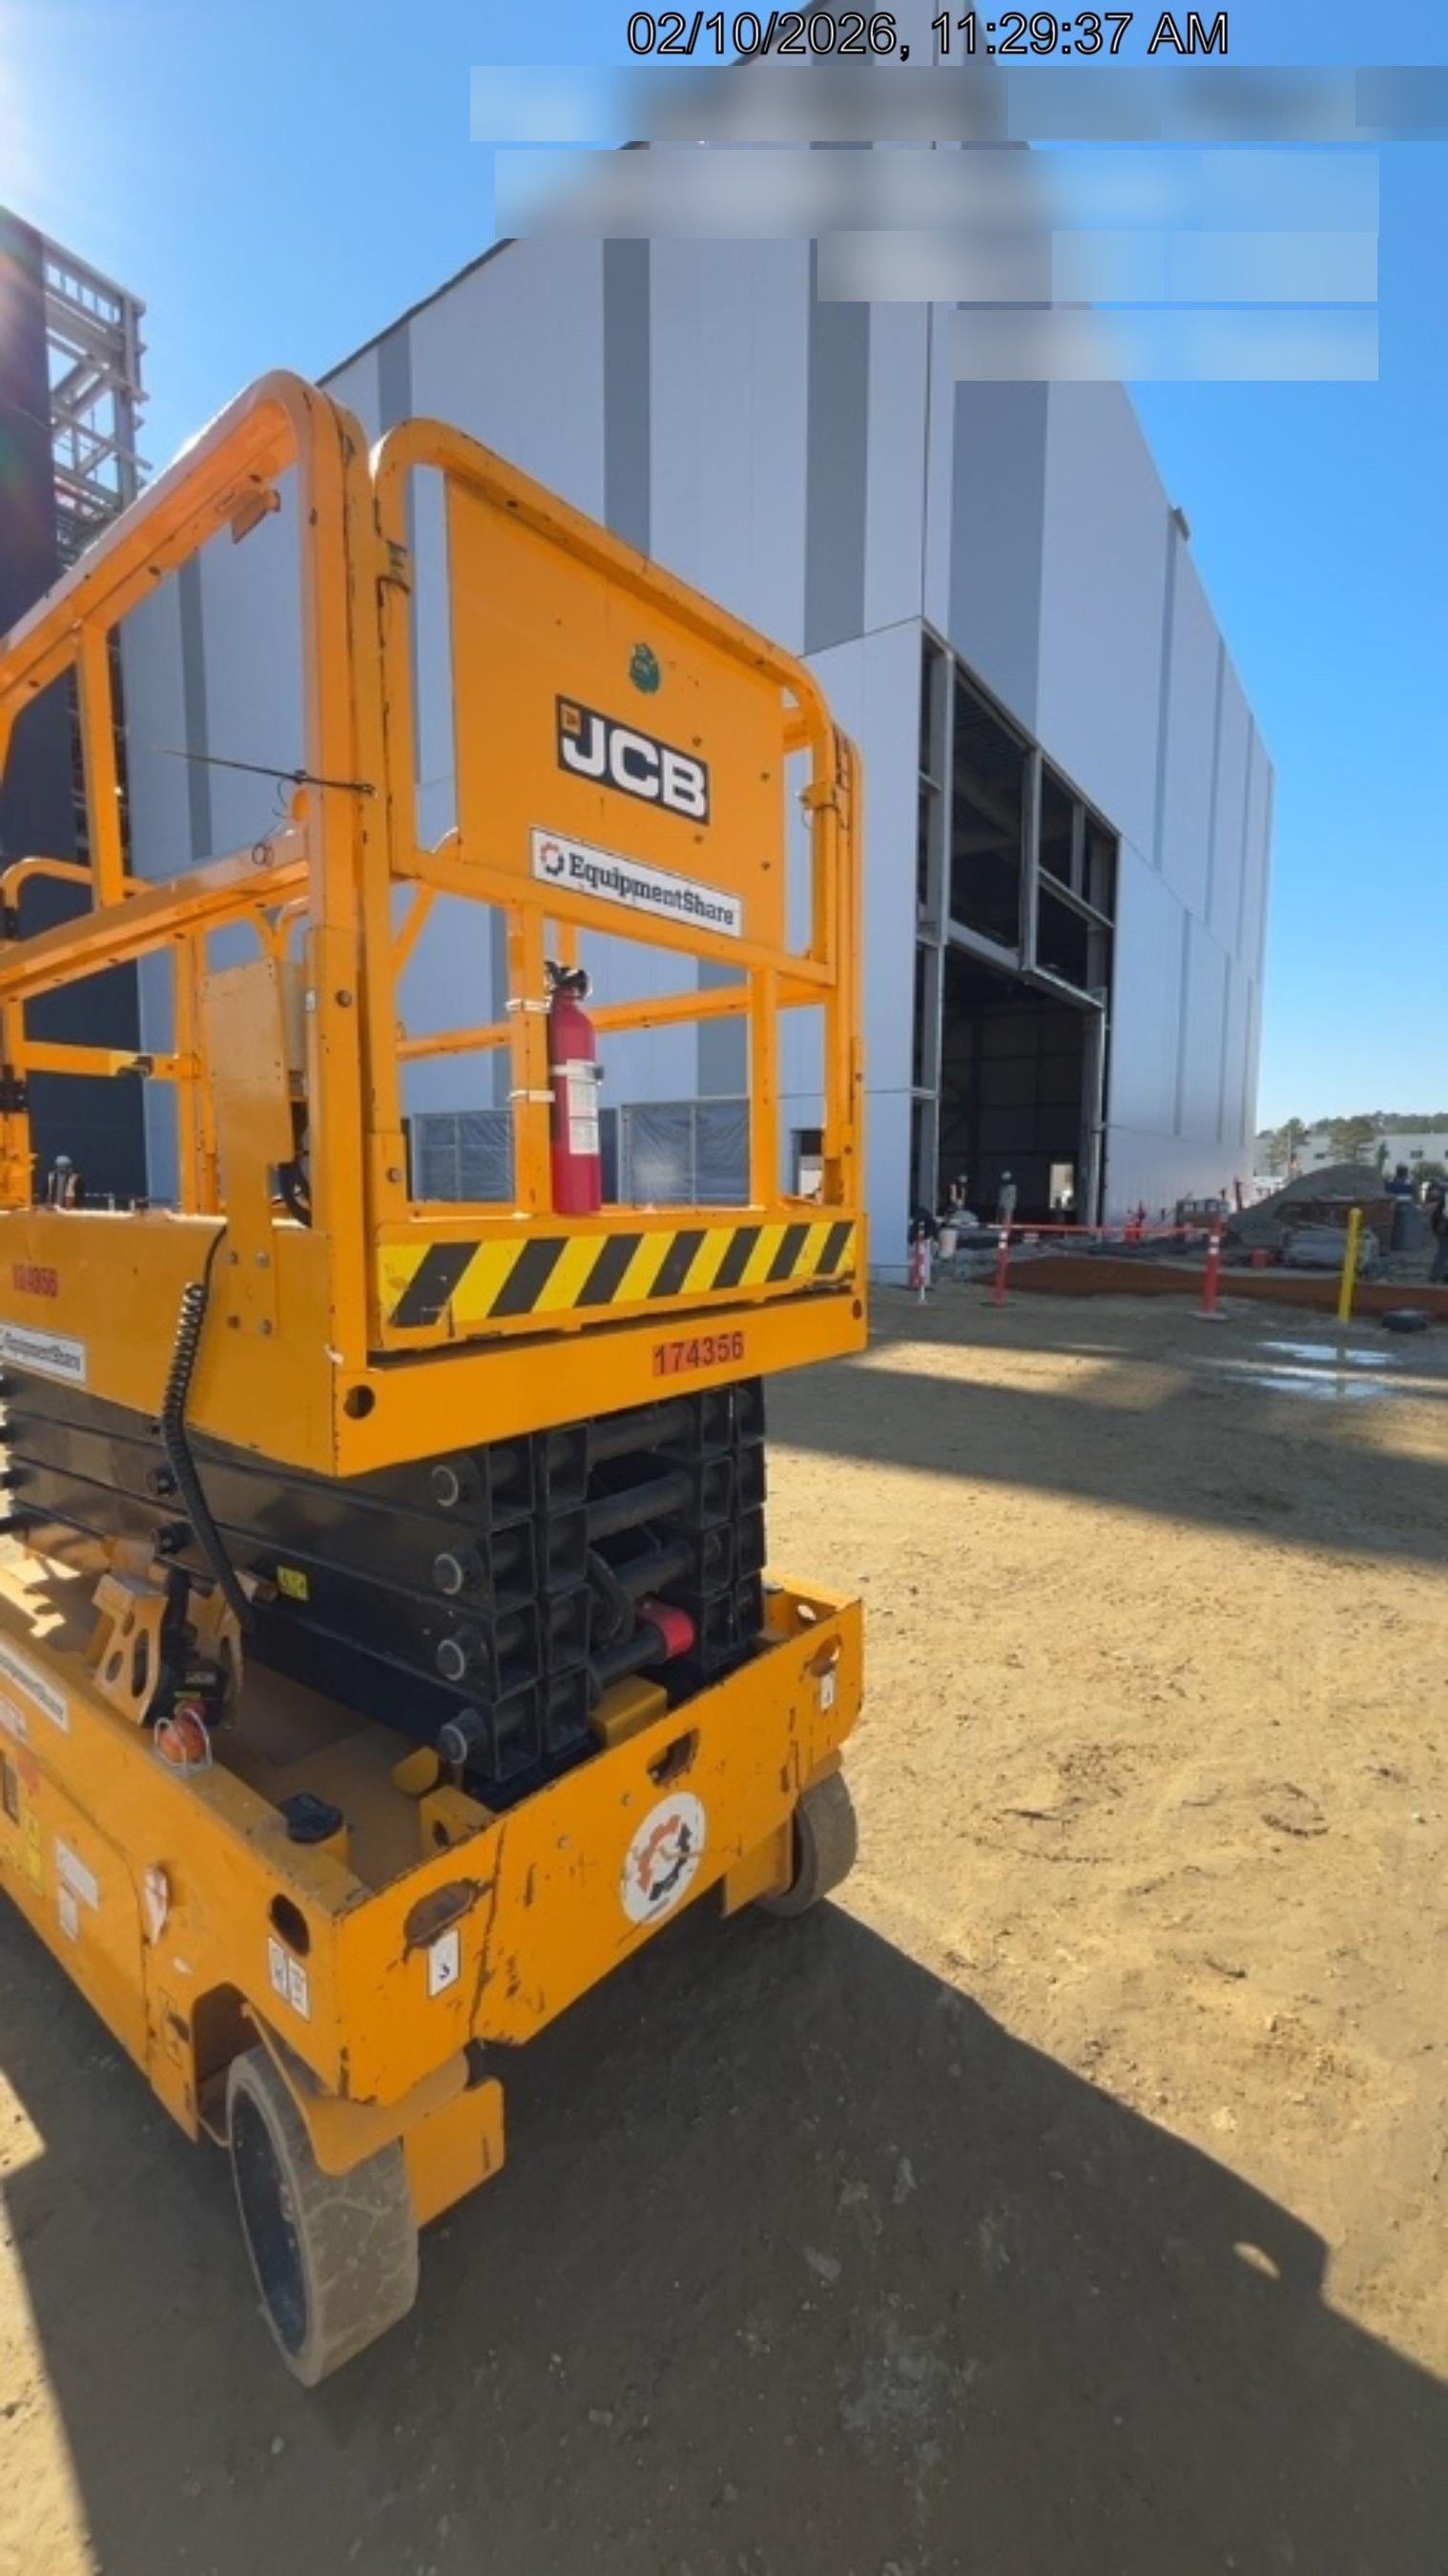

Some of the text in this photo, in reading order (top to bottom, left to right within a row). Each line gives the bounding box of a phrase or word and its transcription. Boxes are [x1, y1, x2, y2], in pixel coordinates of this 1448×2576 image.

[562, 717, 707, 818] JCB
[569, 852, 734, 925] EquipmentShare
[654, 1331, 744, 1375] 174356
